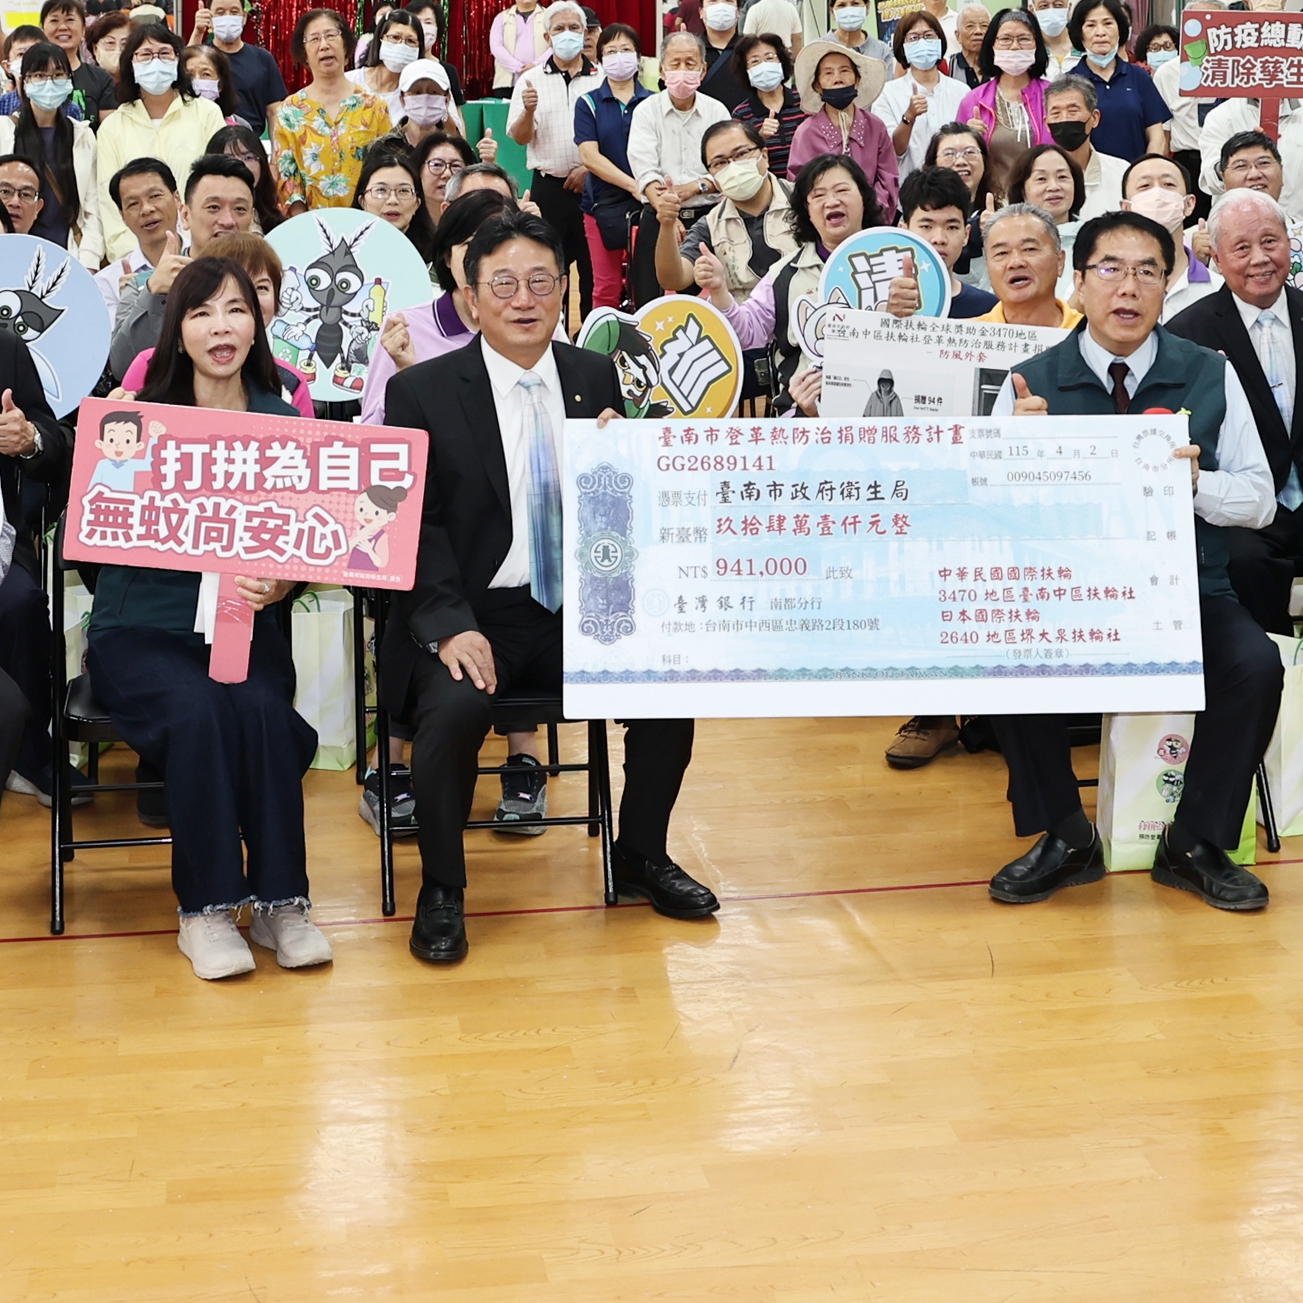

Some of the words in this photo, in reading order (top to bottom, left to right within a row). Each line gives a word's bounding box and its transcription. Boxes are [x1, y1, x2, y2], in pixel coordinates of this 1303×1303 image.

[879, 317, 1038, 341] 國際扶輪全球獎助金3470地區
[660, 315, 732, 415] 巡
[939, 349, 988, 363] 防風外套
[657, 424, 966, 448] 臺南市登革熱防治捐贈服務計畫
[968, 428, 1001, 440] 支票號碼
[969, 449, 1003, 461] 中華民國
[1008, 445, 1029, 457] 115
[1037, 449, 1046, 459] 年
[1055, 445, 1063, 456] 4
[1072, 448, 1081, 459] 月
[1089, 444, 1097, 456] 2
[1110, 449, 1119, 459] 日
[159, 438, 415, 491] 打拼為自己
[656, 455, 777, 472] GG2689141
[971, 476, 989, 487] 帳號
[1006, 471, 1093, 483] 009045097456
[657, 489, 708, 508] 憑票支付
[715, 479, 910, 505] 臺南市政府衛生局
[84, 493, 344, 562] 無蚊尚安心
[658, 526, 709, 544] 新臺幣
[715, 512, 913, 537] 玖拾肆萬壹仟元整
[677, 565, 709, 580] NT$
[715, 556, 809, 578] 941,000
[824, 565, 854, 580] 此致
[937, 566, 1073, 583] 中華民國國際扶輪
[938, 589, 978, 603] 3470
[984, 585, 1137, 603] 地區臺南中區扶輪社
[769, 596, 824, 611] 南都分行
[940, 607, 1041, 624] 日本國際扶輪
[939, 630, 980, 645] 2640
[985, 627, 1122, 645] 地區堺大泉扶輪社
[834, 670, 870, 680] BANK
[875, 670, 894, 680] OF
